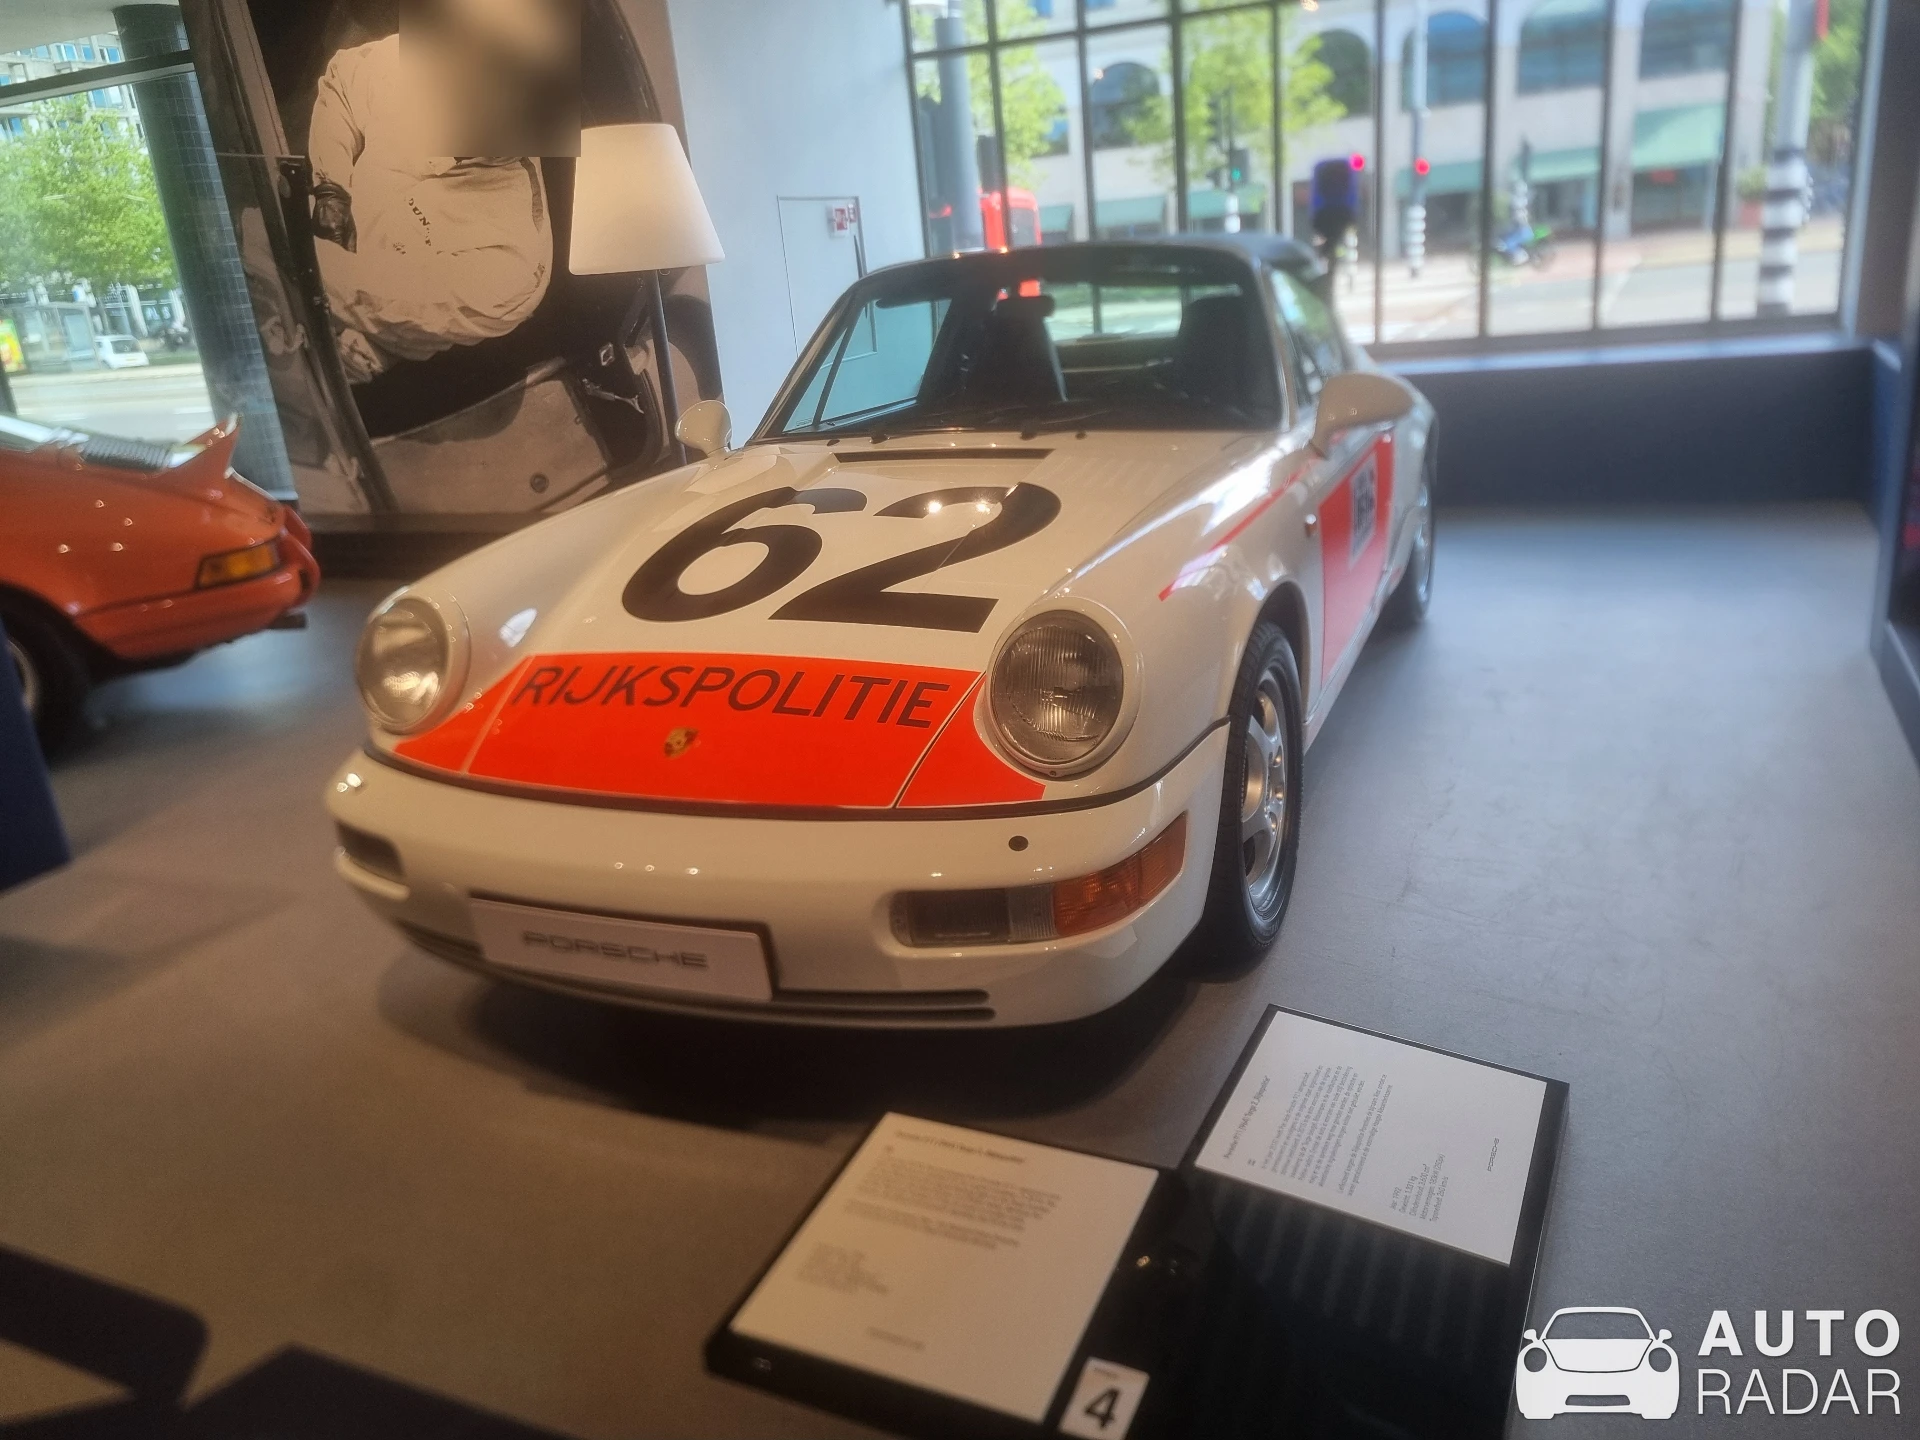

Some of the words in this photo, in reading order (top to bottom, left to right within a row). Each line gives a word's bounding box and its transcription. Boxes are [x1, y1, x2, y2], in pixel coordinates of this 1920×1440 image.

[621, 482, 1061, 633] 62
[511, 664, 951, 729] RIJKSPOLITIE
[522, 930, 708, 969] PORSCHE
[1487, 1138, 1499, 1171] PORSCHE
[1084, 1388, 1120, 1429] 4
